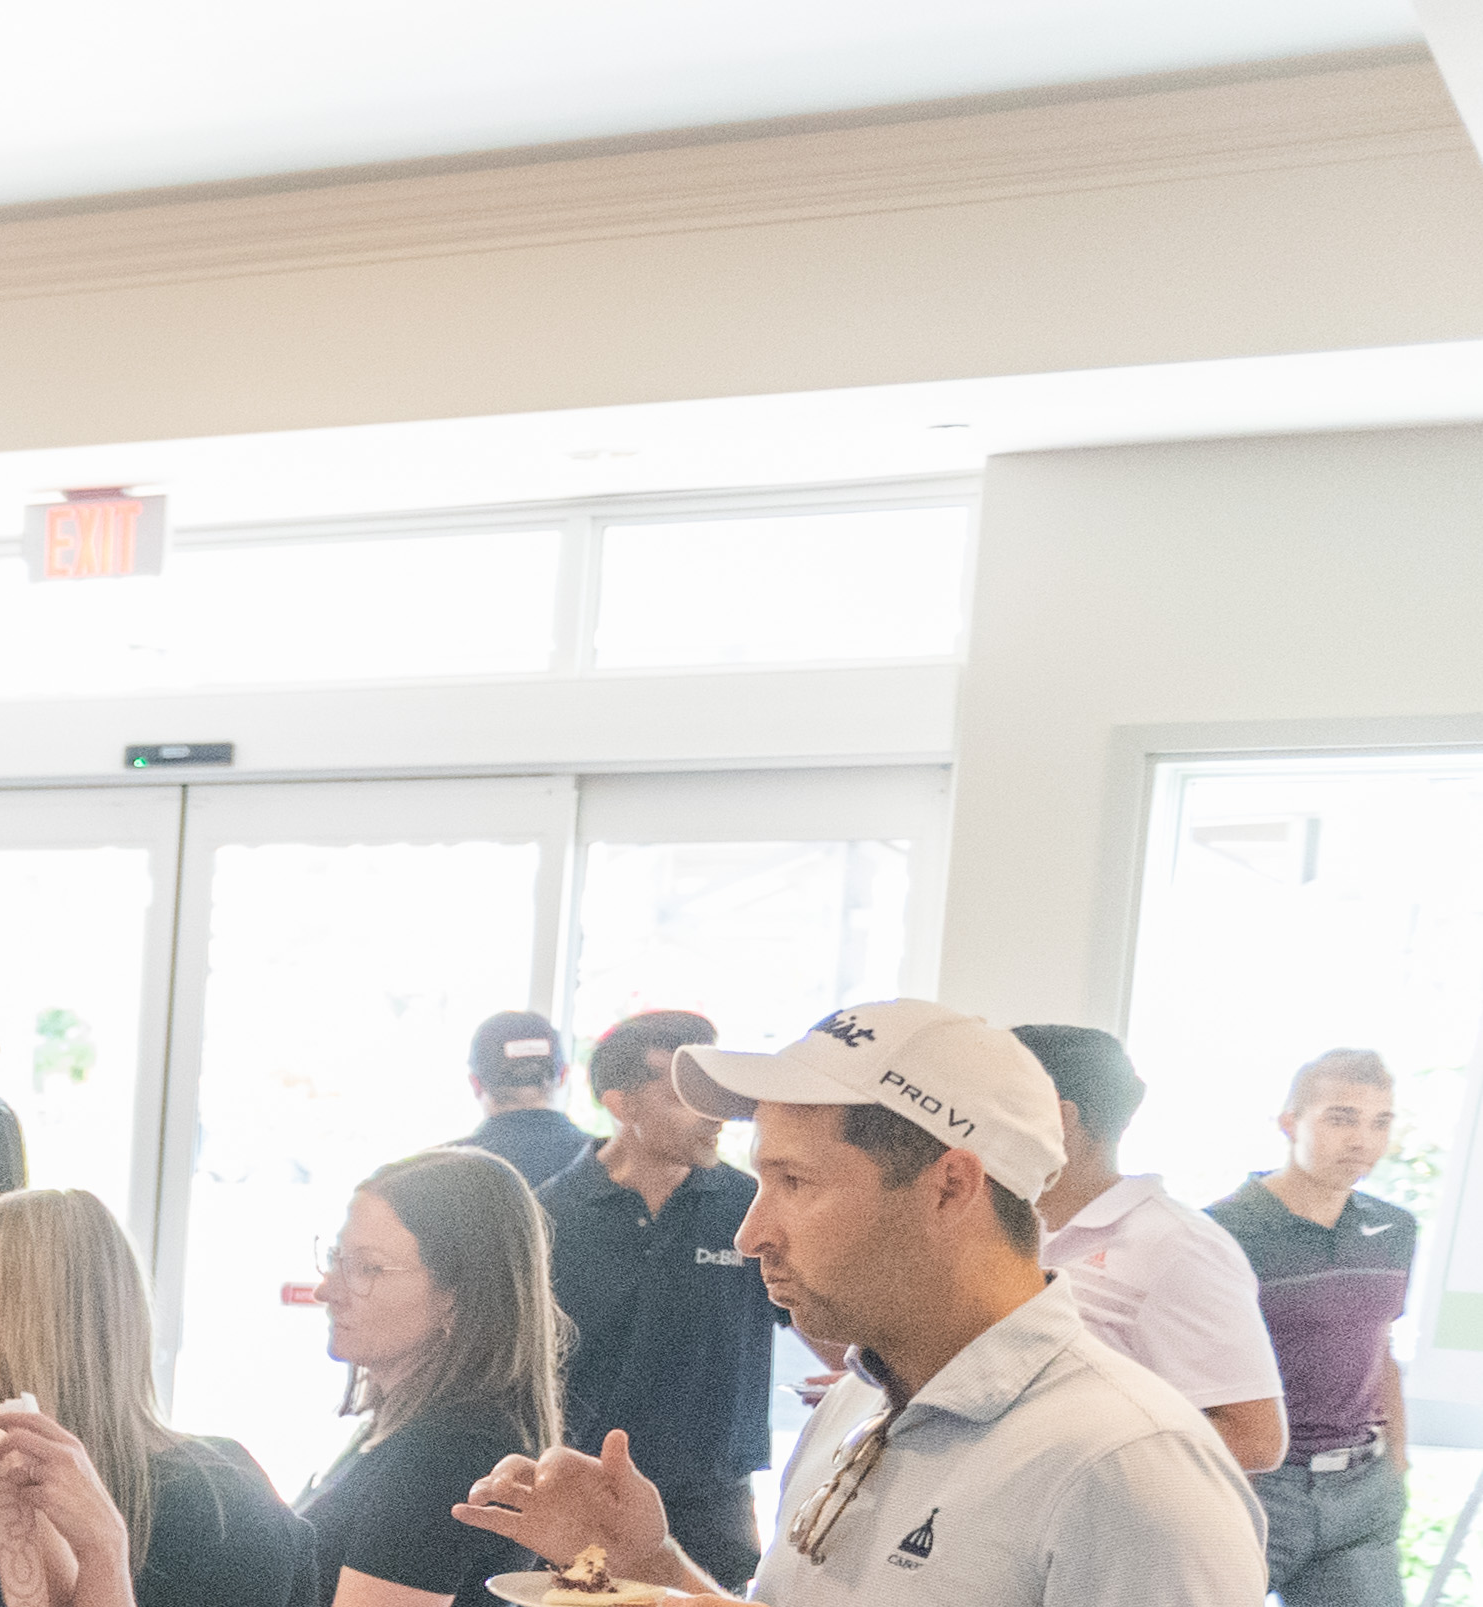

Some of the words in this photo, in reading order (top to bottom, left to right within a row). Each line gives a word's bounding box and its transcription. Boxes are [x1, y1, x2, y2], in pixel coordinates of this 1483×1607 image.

[44, 501, 143, 579] EXIT
[879, 1070, 942, 1115] PRO
[948, 1108, 976, 1138] V1
